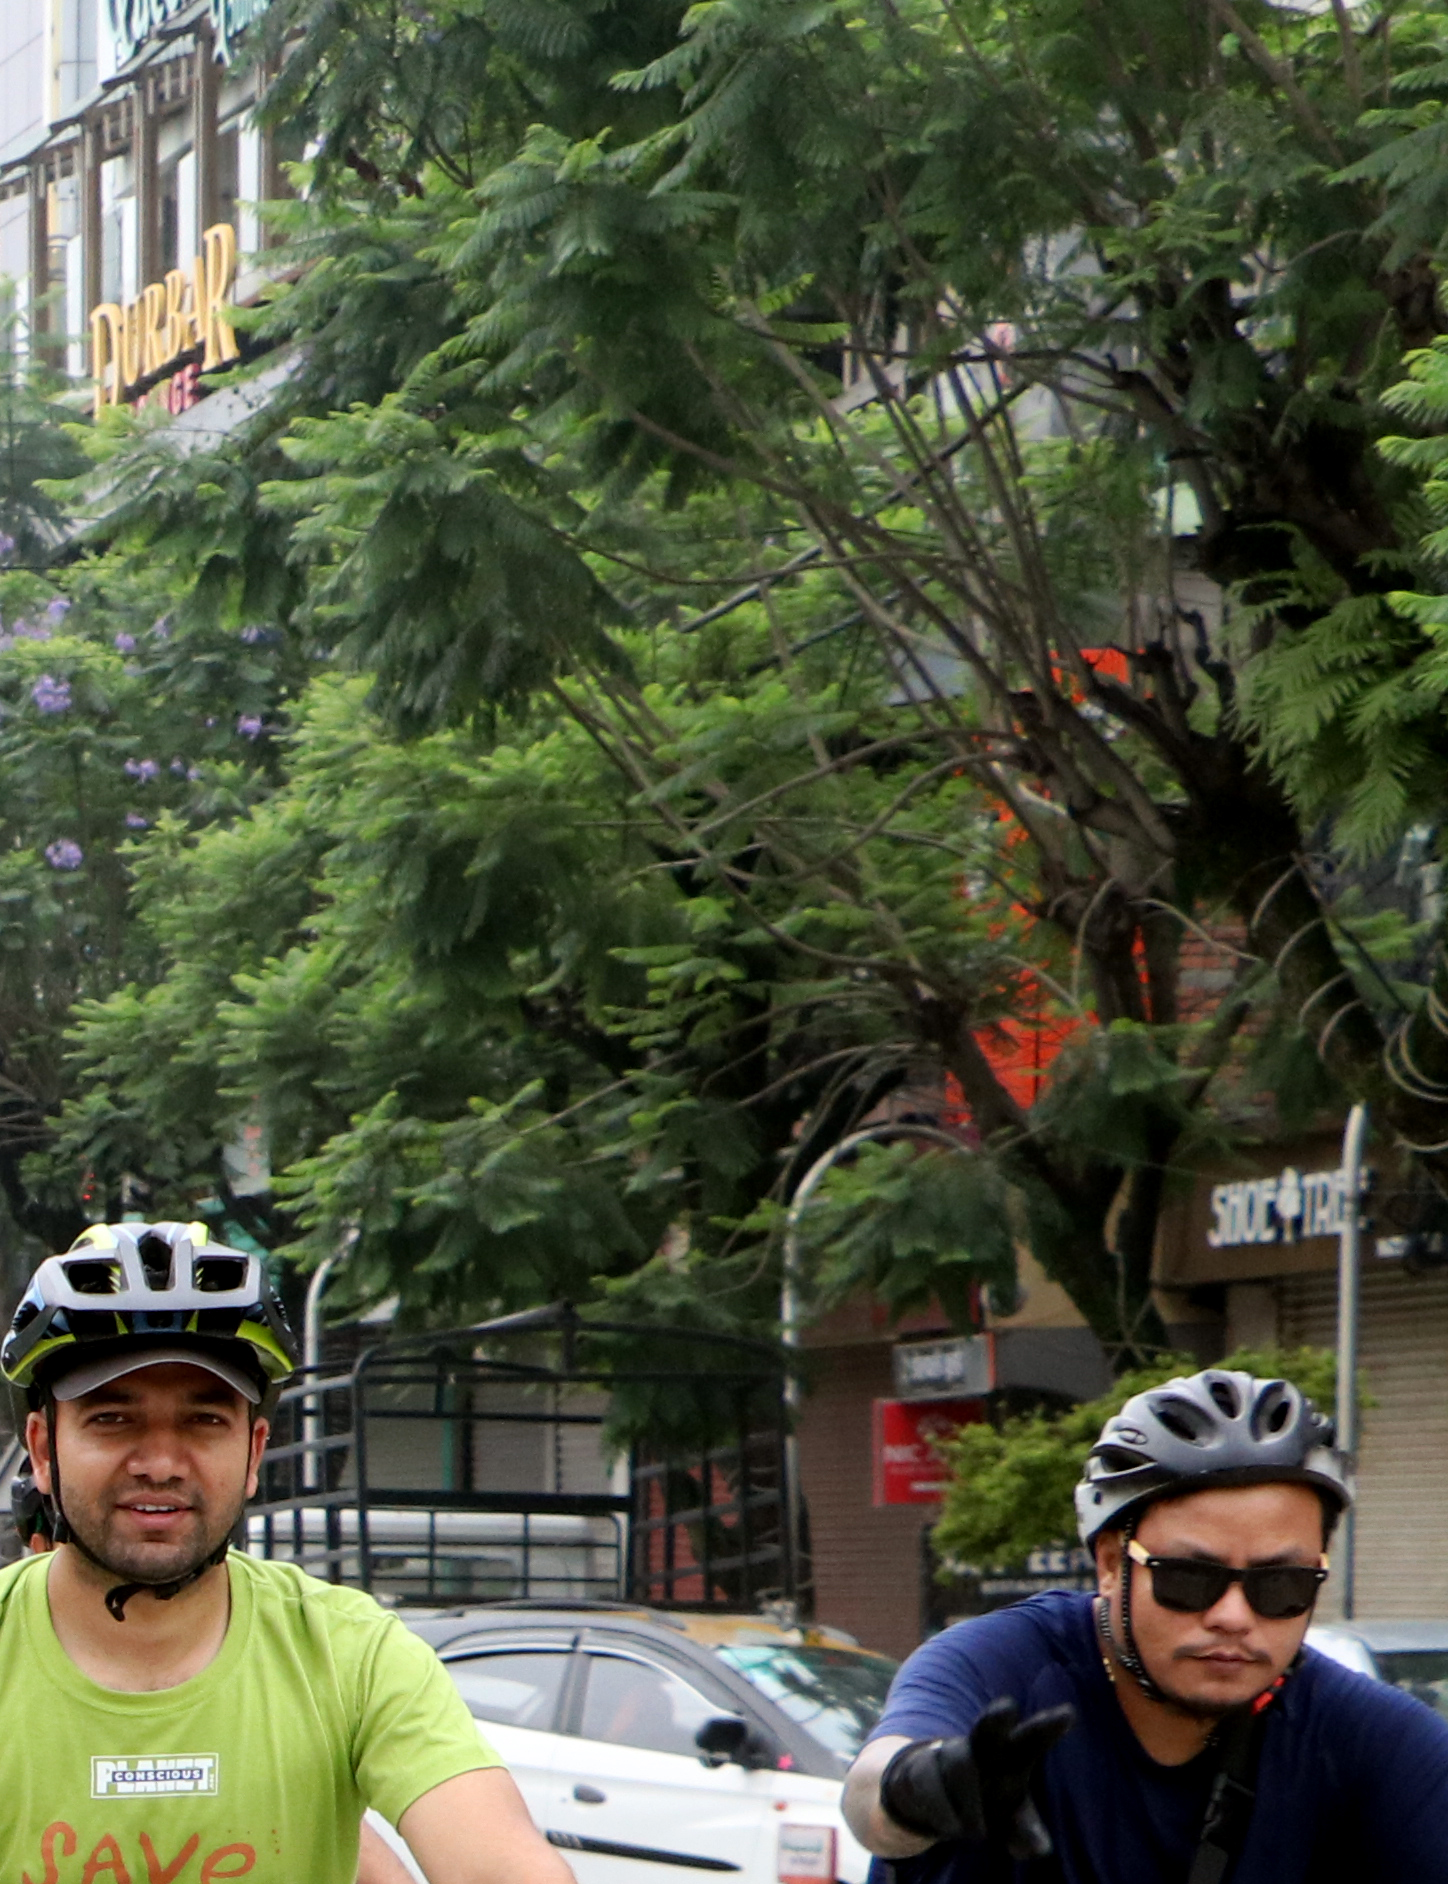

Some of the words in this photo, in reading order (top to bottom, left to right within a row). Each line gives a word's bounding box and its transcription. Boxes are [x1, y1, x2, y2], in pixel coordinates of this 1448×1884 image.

[90, 222, 241, 421] DURBAR
[1208, 1177, 1277, 1248] SHOE
[96, 1758, 214, 1793] PLANET
[114, 1770, 201, 1781] CONSCIOUS
